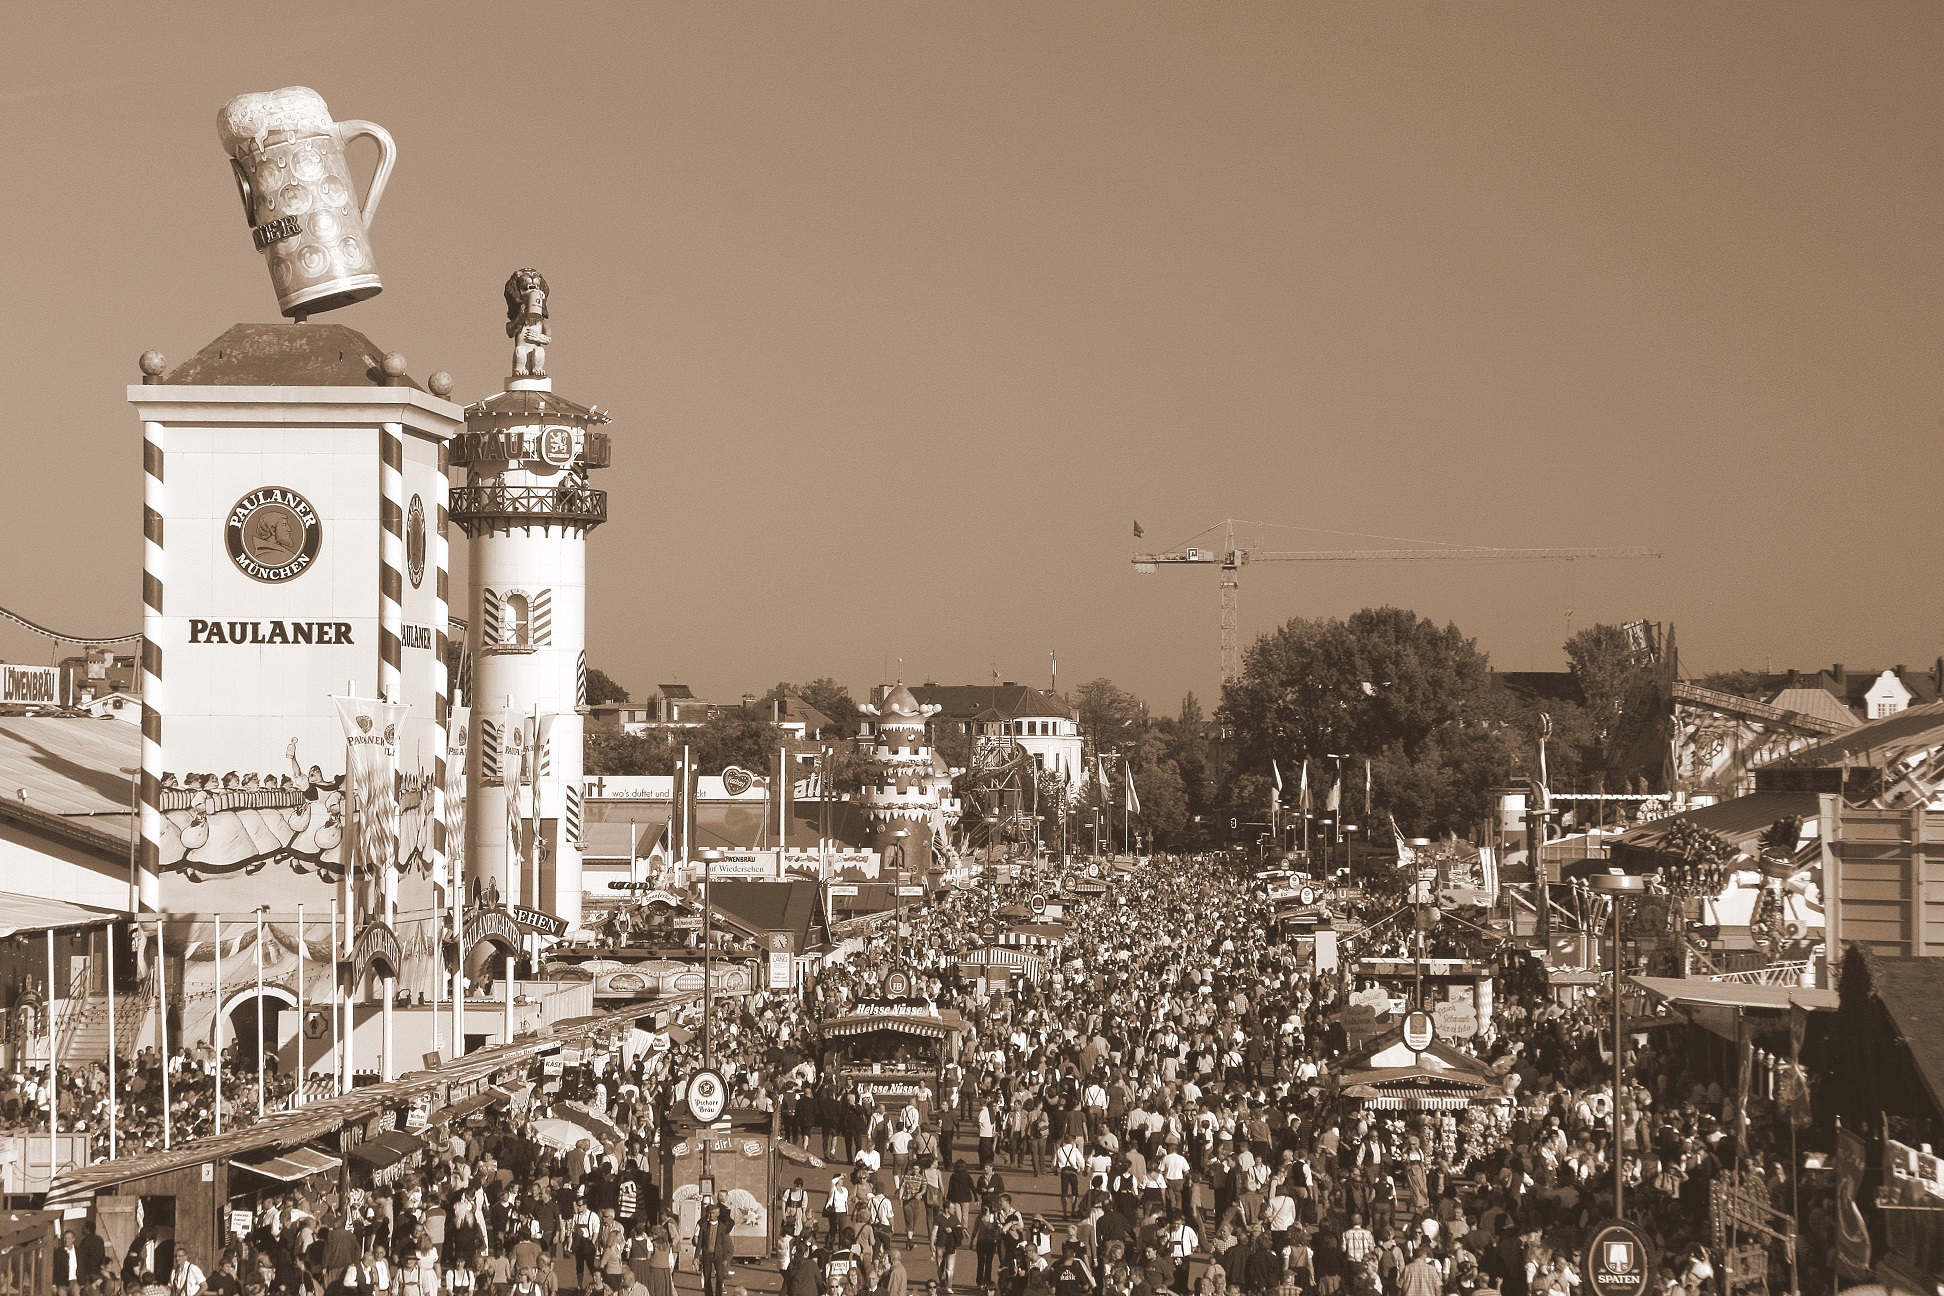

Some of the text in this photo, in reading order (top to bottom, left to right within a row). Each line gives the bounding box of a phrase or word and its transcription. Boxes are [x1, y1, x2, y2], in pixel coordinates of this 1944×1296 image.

[229, 489, 317, 529] PAULANER
[235, 552, 310, 580] MÜNCHEN
[188, 619, 354, 645] PAULANER
[3, 666, 55, 701] LÖWENBRÄU
[612, 789, 629, 798] wo's
[632, 788, 653, 798] duftet
[655, 788, 670, 798] und
[1339, 891, 1347, 899] U
[462, 912, 522, 961] PAULANERGARTEN
[856, 1003, 923, 1015] Heisse Nüsse
[857, 1082, 889, 1094] Hisse
[694, 1099, 719, 1107] Pschorr
[698, 1105, 715, 1113] Bräu
[1598, 1275, 1640, 1284] SPATEN
